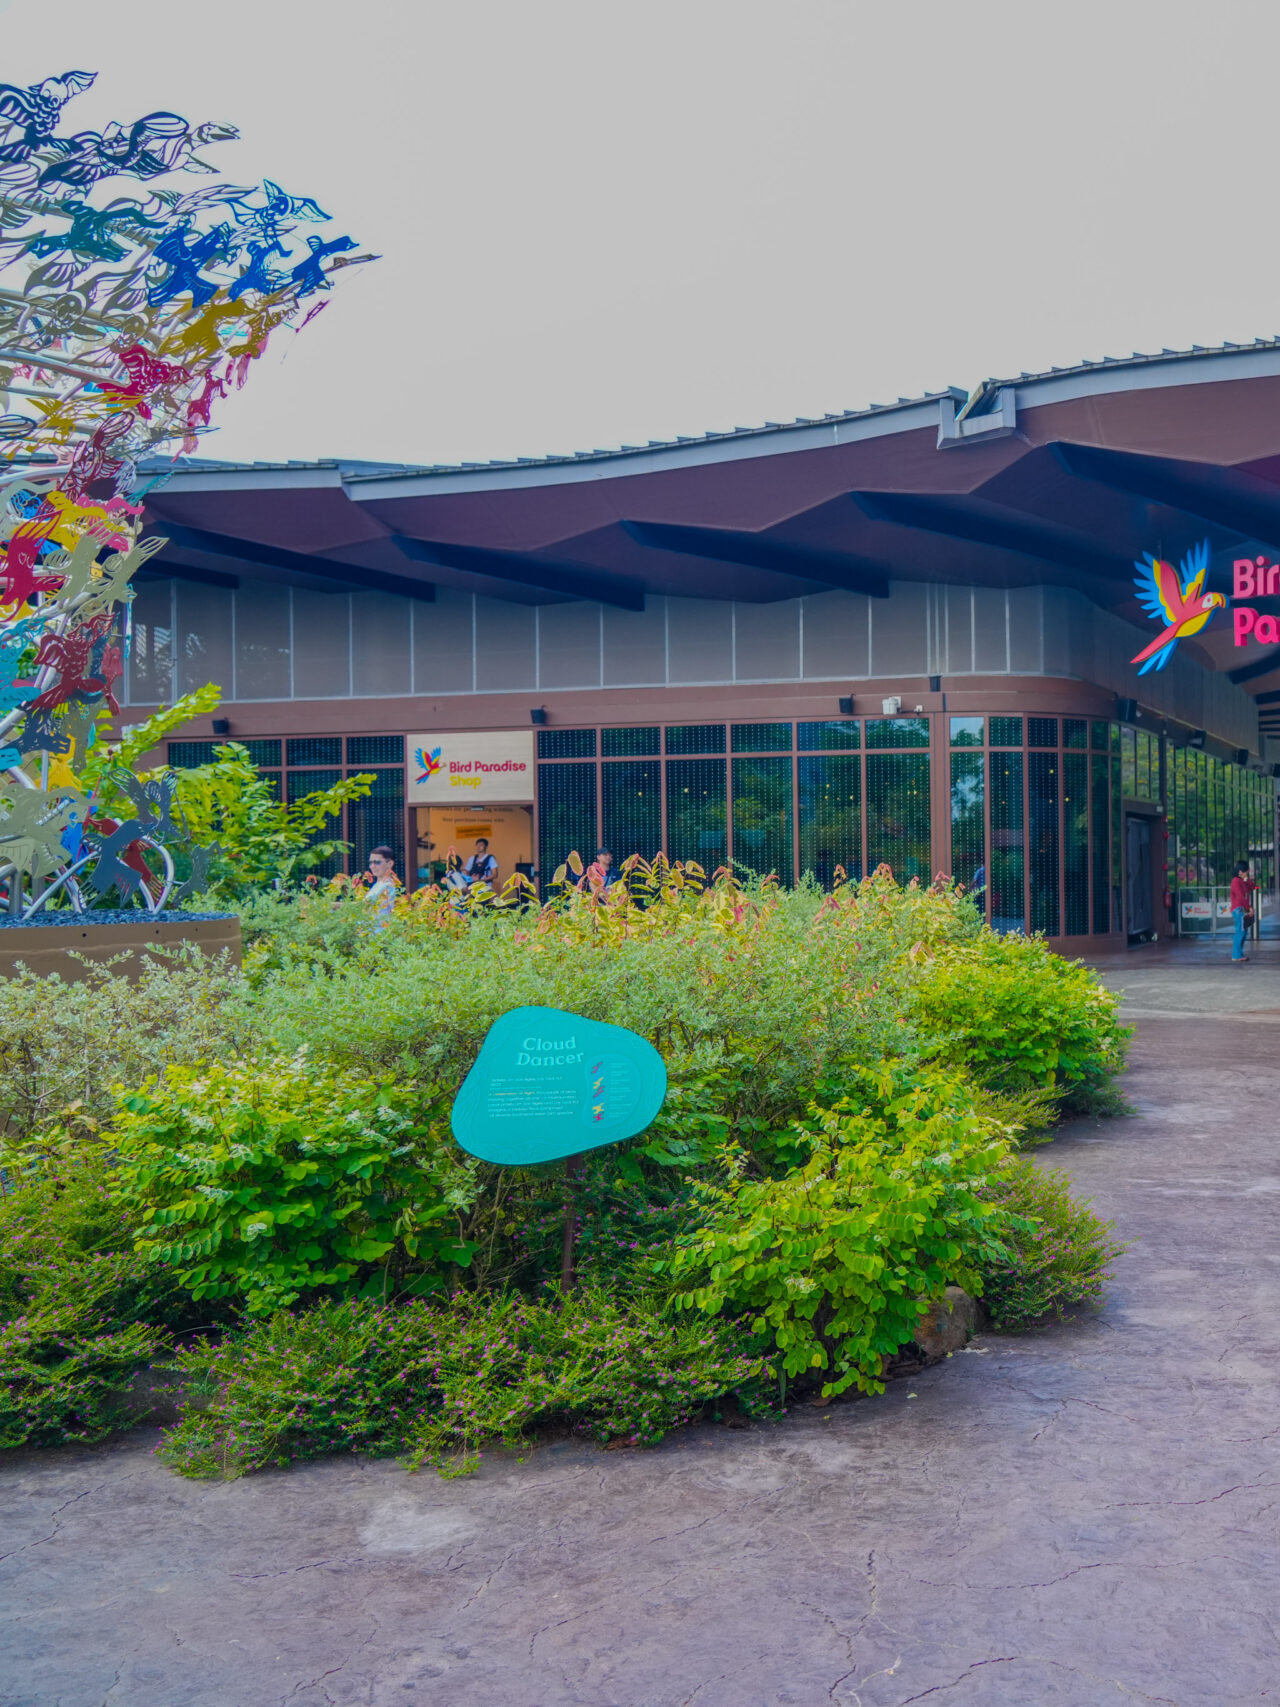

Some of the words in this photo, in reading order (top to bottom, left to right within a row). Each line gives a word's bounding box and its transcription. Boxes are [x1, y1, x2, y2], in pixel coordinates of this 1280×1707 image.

[449, 761, 472, 773] Bird
[474, 760, 527, 772] Paradise
[449, 775, 482, 789] Shop
[523, 1036, 576, 1051] Cloud
[517, 1052, 584, 1066] Dancer
